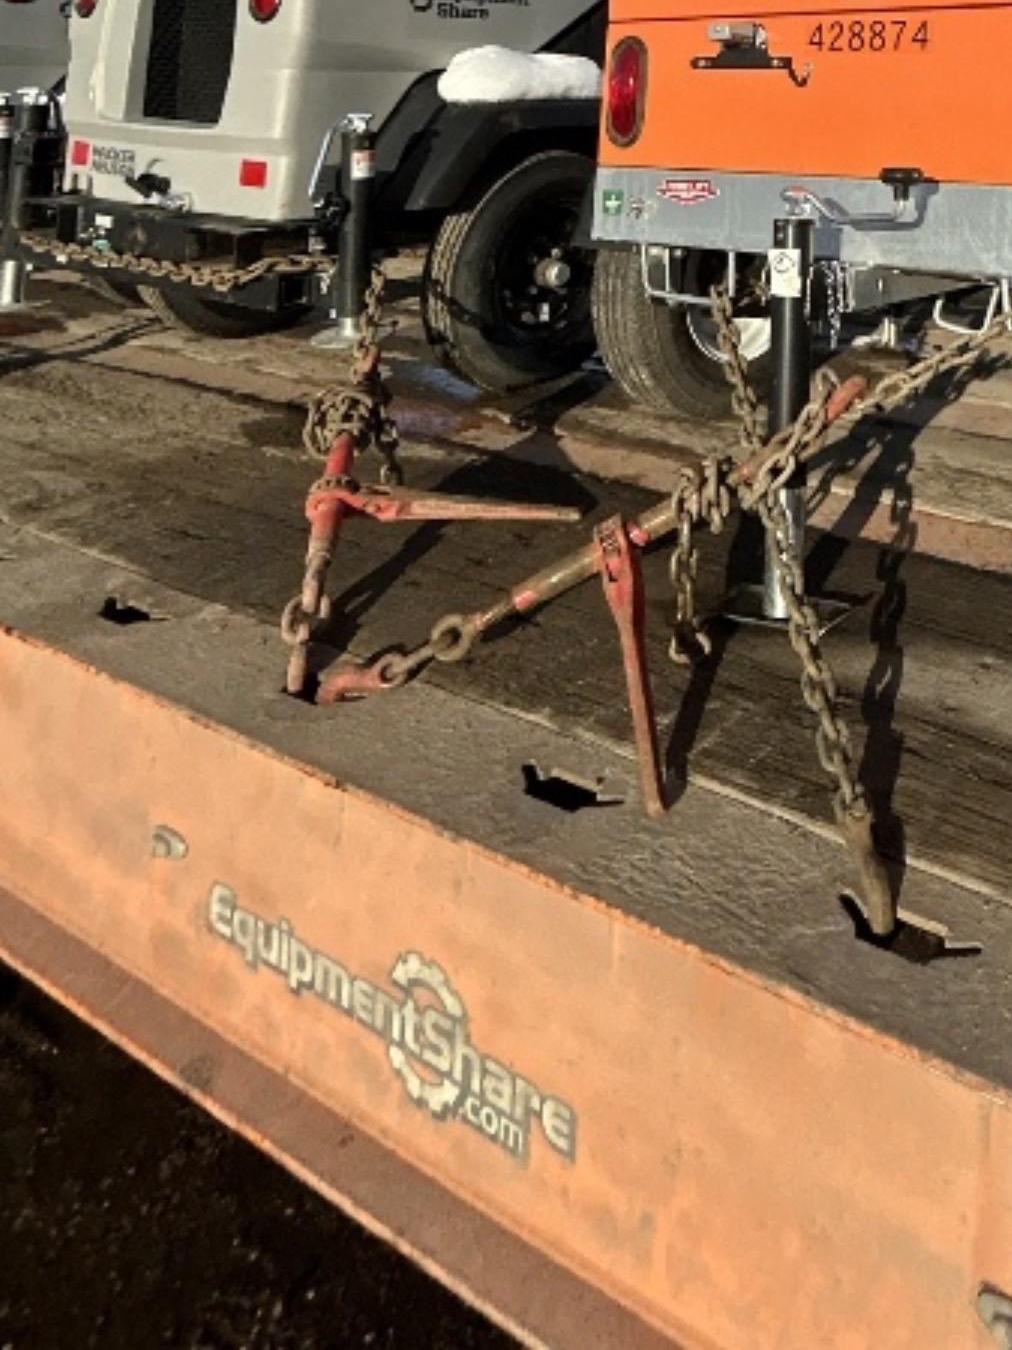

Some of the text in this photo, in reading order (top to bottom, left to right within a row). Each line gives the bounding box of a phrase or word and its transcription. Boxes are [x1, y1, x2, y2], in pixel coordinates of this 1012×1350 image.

[808, 20, 929, 51] 428874
[208, 883, 573, 1154] EquipmentShare
[458, 1096, 525, 1153] .com
